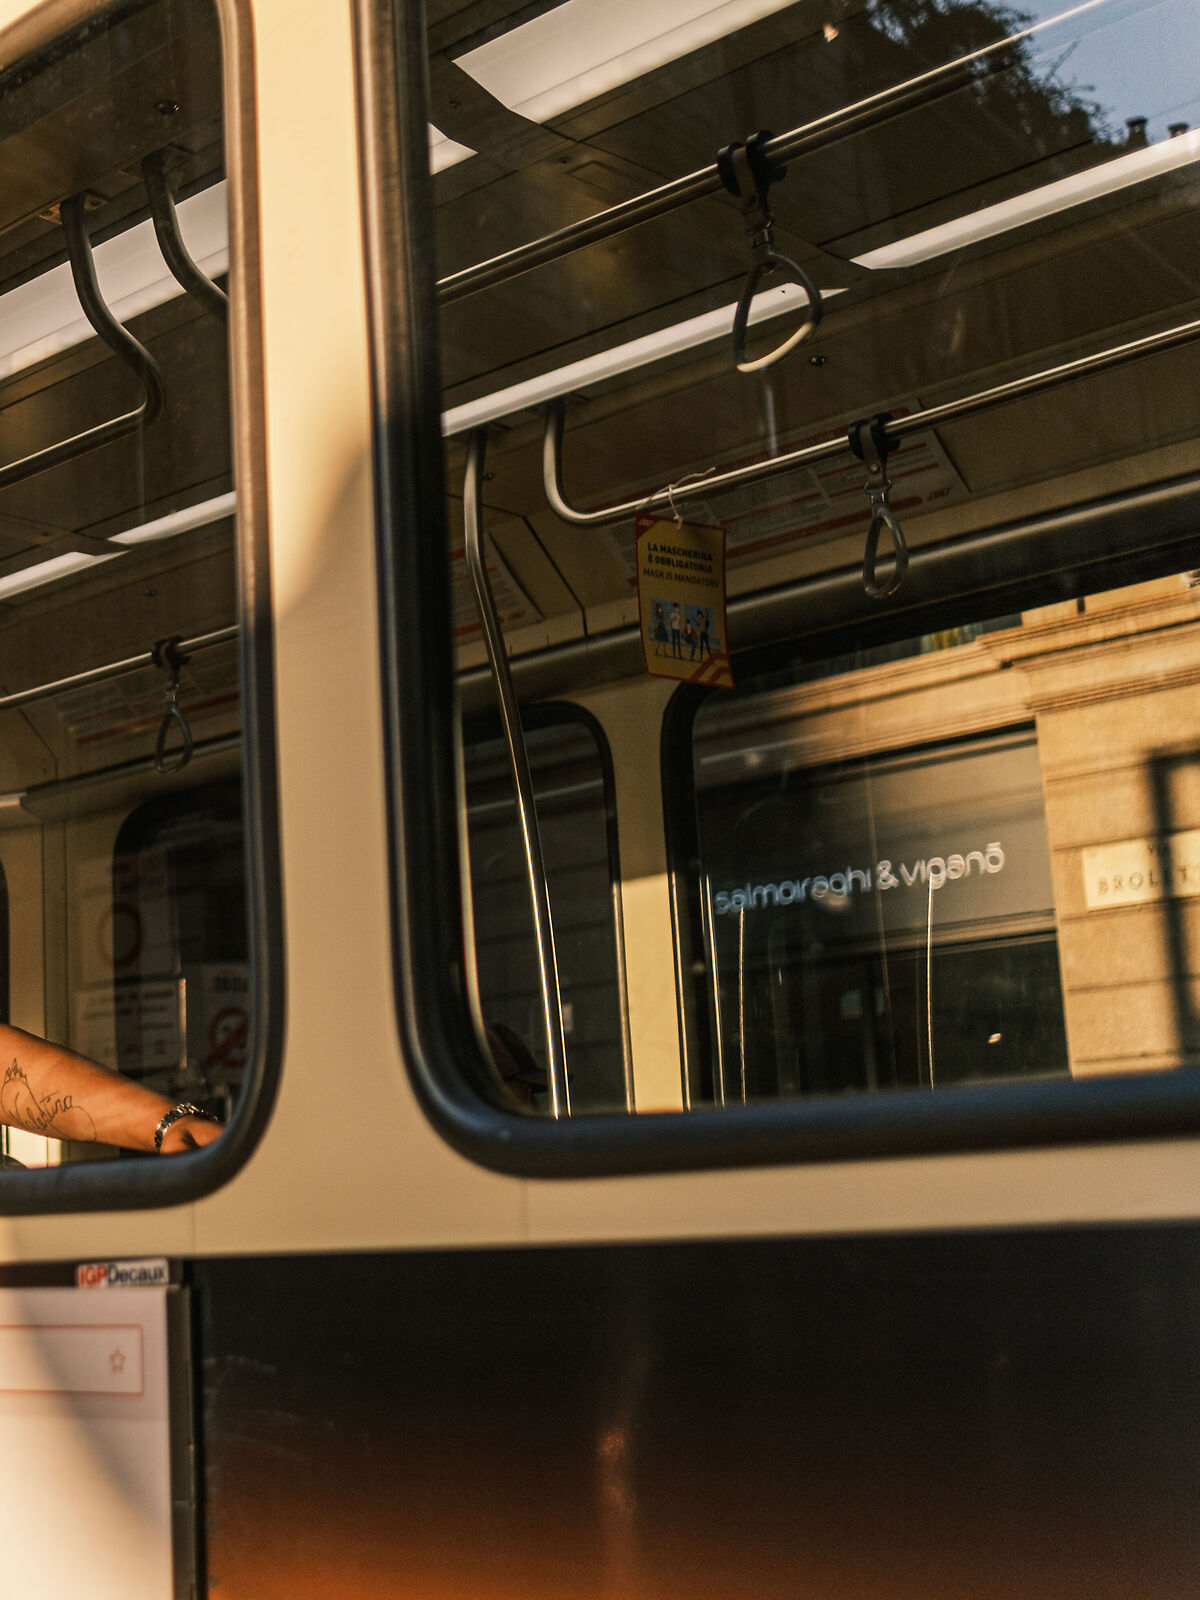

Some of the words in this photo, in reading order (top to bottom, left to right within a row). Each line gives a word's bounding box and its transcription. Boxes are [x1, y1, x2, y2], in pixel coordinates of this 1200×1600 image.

[648, 542, 658, 553] LA
[660, 544, 713, 561] MASCHERINA
[655, 556, 713, 573] OBBLIGATORIA
[643, 567, 665, 578] MASK
[666, 571, 673, 580] IS
[674, 573, 720, 588] MANDATORY
[714, 866, 872, 915] salmoiraghi
[876, 860, 899, 890] &
[79, 1263, 165, 1285] IGPDecaux
